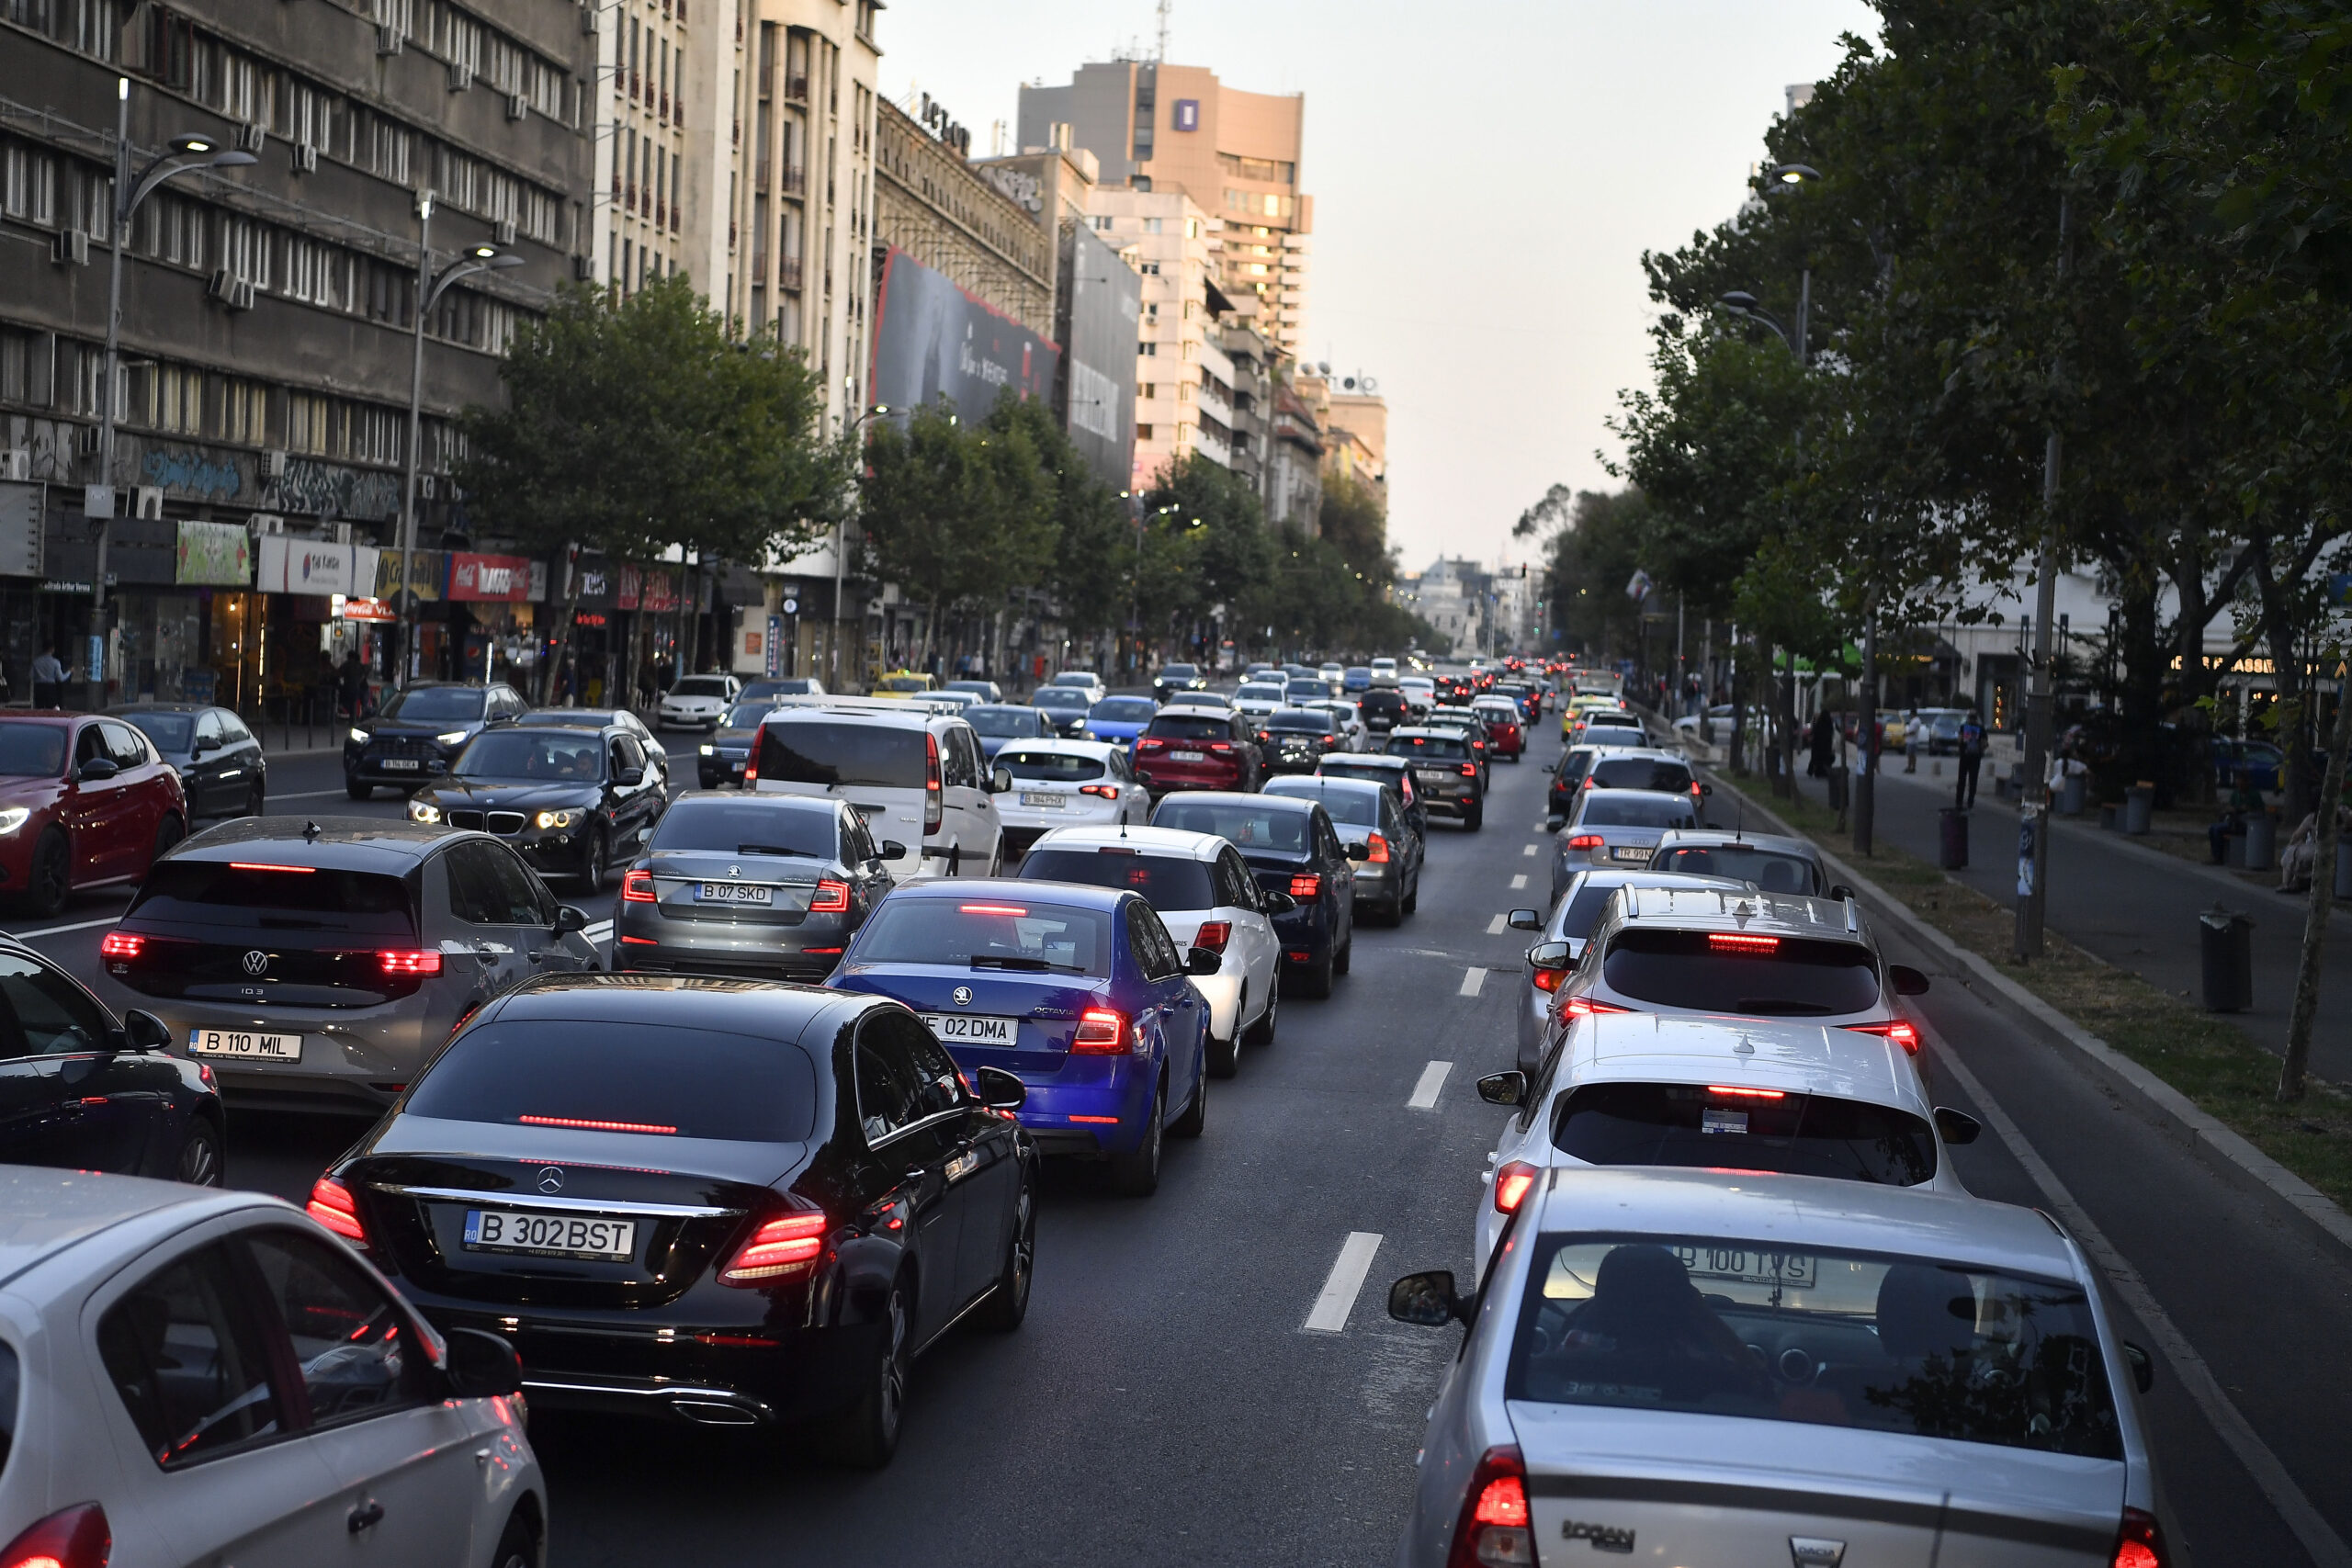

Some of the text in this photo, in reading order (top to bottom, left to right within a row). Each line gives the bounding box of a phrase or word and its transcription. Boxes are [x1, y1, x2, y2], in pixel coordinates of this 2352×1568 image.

[704, 886, 766, 900] B 07 SKD
[1035, 1007, 1075, 1015] OCTAVIA
[944, 1018, 967, 1036] 02
[971, 1020, 1007, 1039] DMA
[188, 1042, 198, 1050] RO
[207, 1032, 287, 1055] B 110 MIL
[464, 1229, 477, 1240] RO
[481, 1214, 503, 1242] B
[1679, 1246, 1696, 1269] B
[1706, 1248, 1746, 1273] 100
[1562, 1519, 1636, 1545] LOGAN
[1798, 1545, 1837, 1557] DACIA
